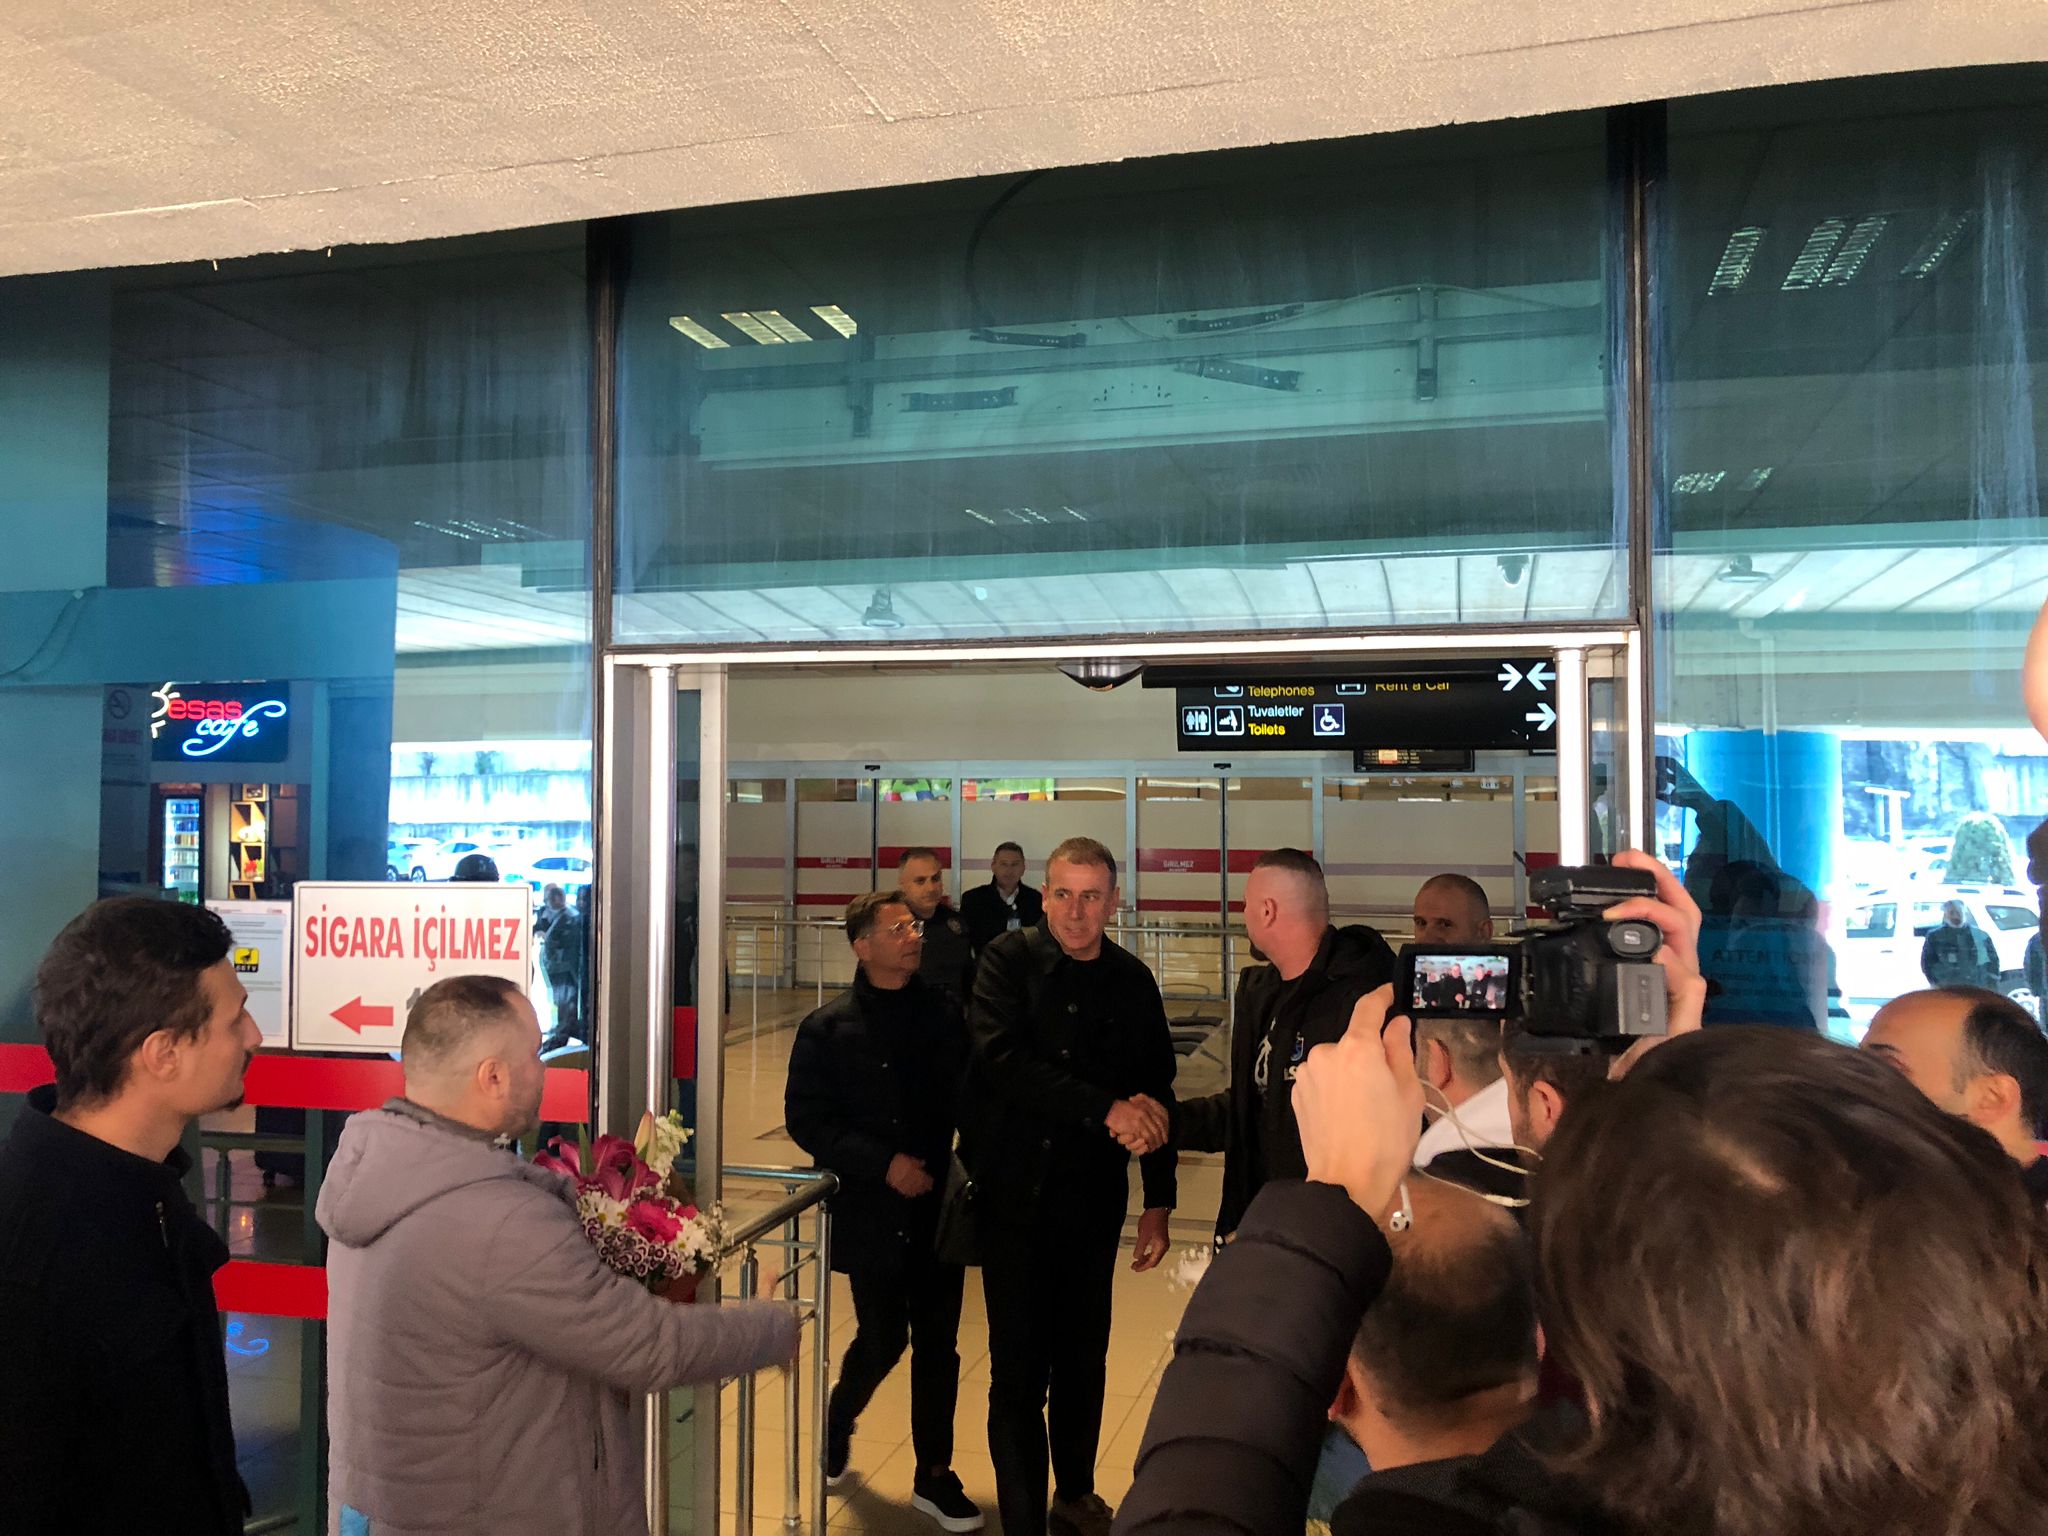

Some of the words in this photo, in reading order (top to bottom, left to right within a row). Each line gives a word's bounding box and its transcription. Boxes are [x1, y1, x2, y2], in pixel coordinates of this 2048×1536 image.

[1248, 686, 1315, 698] Telephones
[168, 699, 242, 720] esas
[1247, 705, 1304, 718] Tuvaletler
[182, 700, 287, 756] cafe
[1248, 723, 1286, 736] Toilets
[305, 904, 404, 958] SİGARA
[414, 904, 521, 972] İÇİLMEZ
